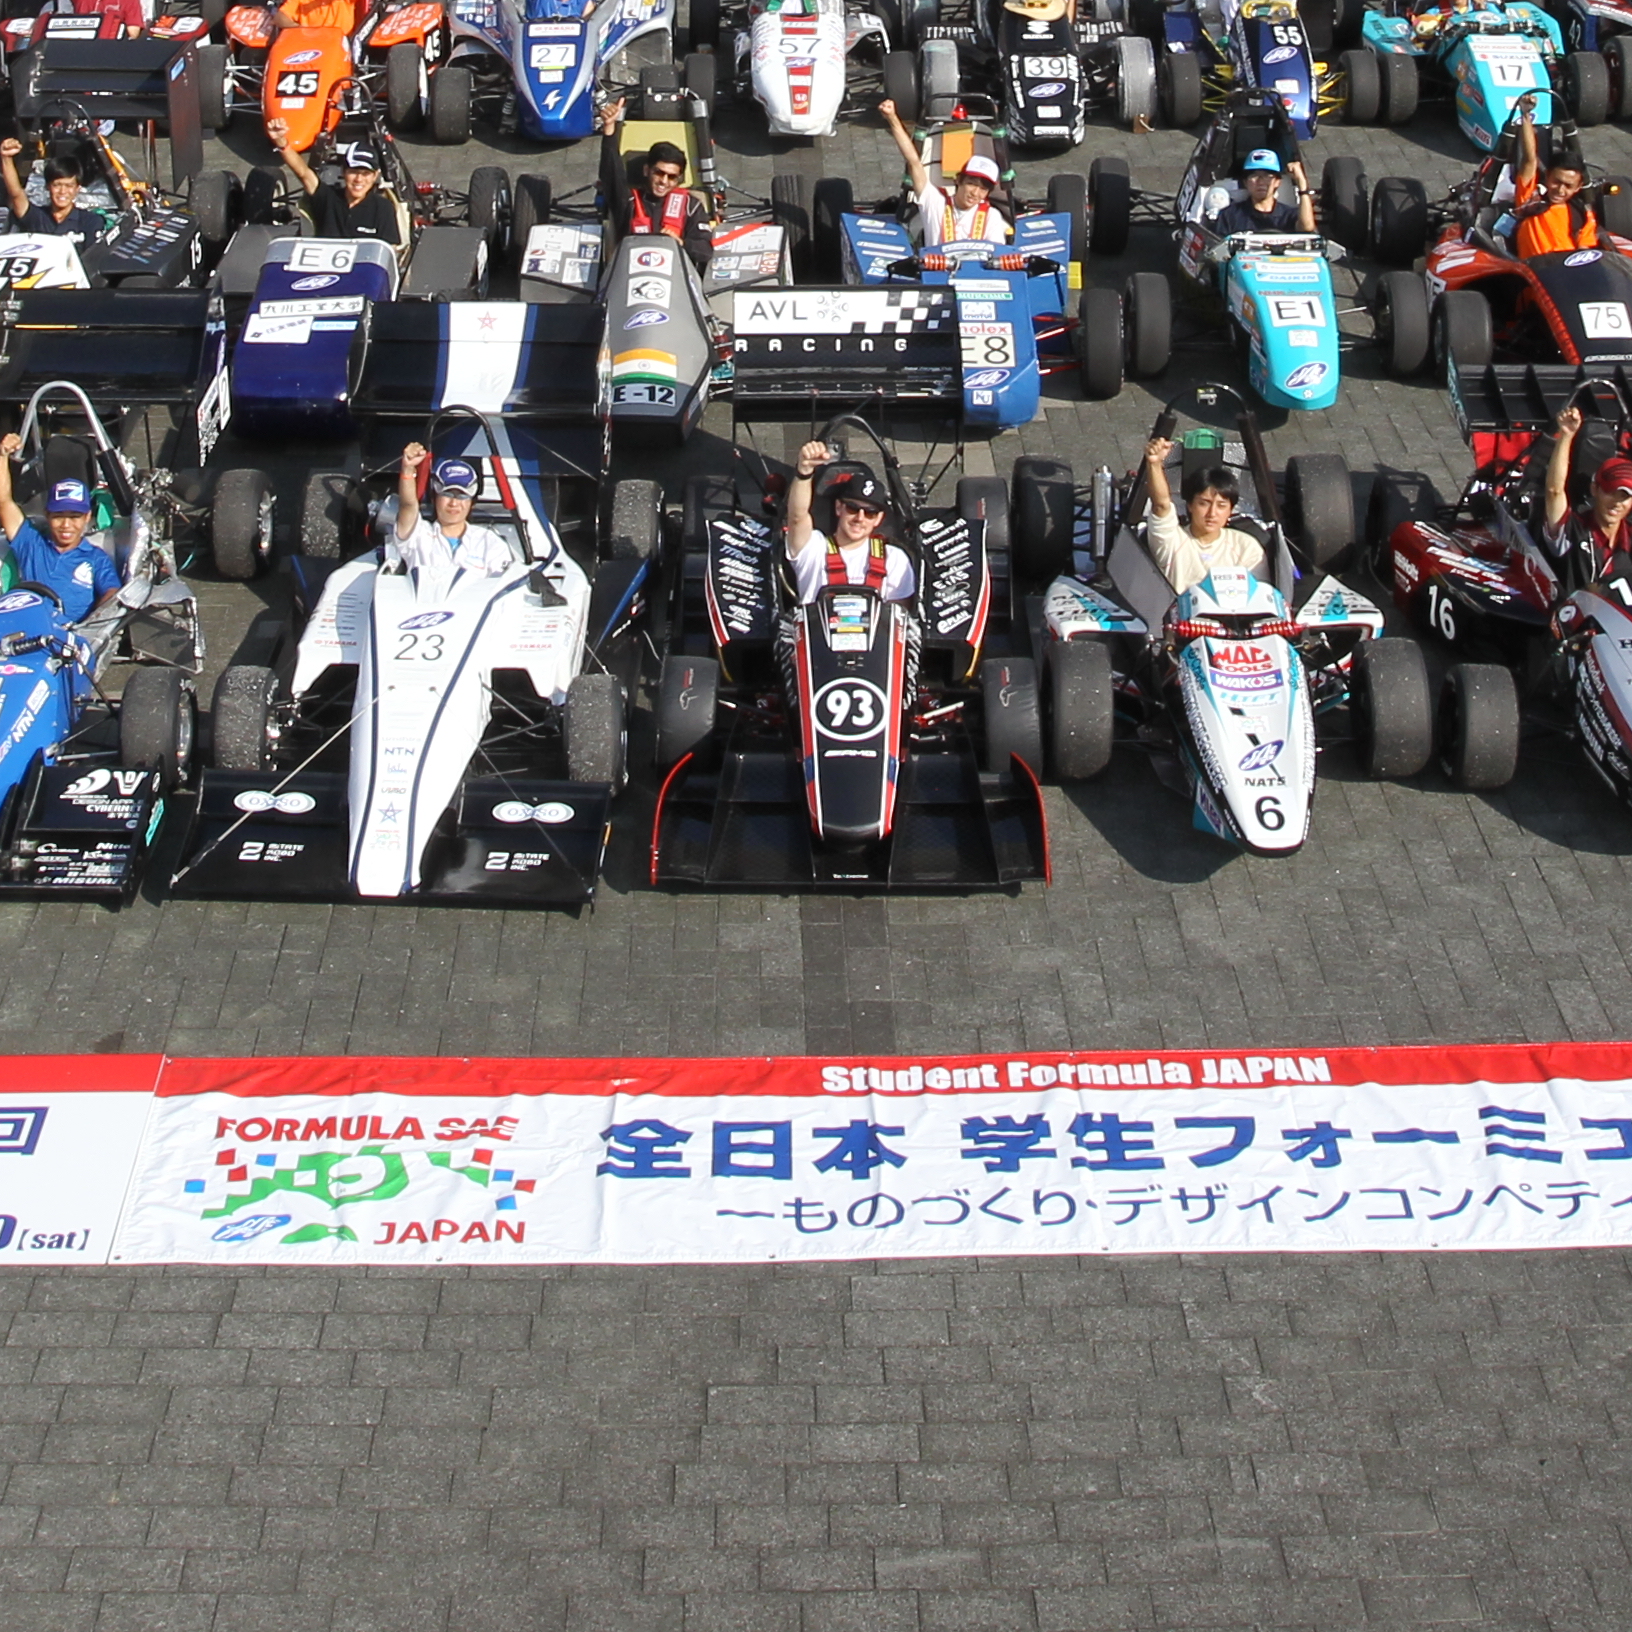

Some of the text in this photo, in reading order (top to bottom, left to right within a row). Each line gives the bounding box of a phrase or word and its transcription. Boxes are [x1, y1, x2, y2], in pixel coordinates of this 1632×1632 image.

[778, 37, 823, 55] 57
[1273, 25, 1303, 47] 55
[535, 47, 571, 63] 27
[1027, 57, 1066, 77] 39
[1496, 65, 1523, 81] 17
[277, 72, 319, 95] 45
[192, 231, 202, 270] 15
[749, 299, 809, 322] AVL
[1274, 300, 1317, 320] E1
[1587, 306, 1624, 330] 75
[734, 337, 909, 353] RACING
[613, 385, 675, 407] E-12
[1428, 584, 1456, 641] 16
[392, 633, 446, 662] 23
[825, 687, 874, 728] 93
[11, 710, 36, 744] NTN
[383, 746, 416, 757] NTN
[1244, 776, 1287, 788] NATS
[1254, 795, 1286, 832] 6
[821, 1054, 1333, 1094] Student Formula JAPAN
[214, 1115, 520, 1142] FORMULA SAE
[595, 1118, 910, 1181] 全日本
[372, 1218, 527, 1245] JAPAN
